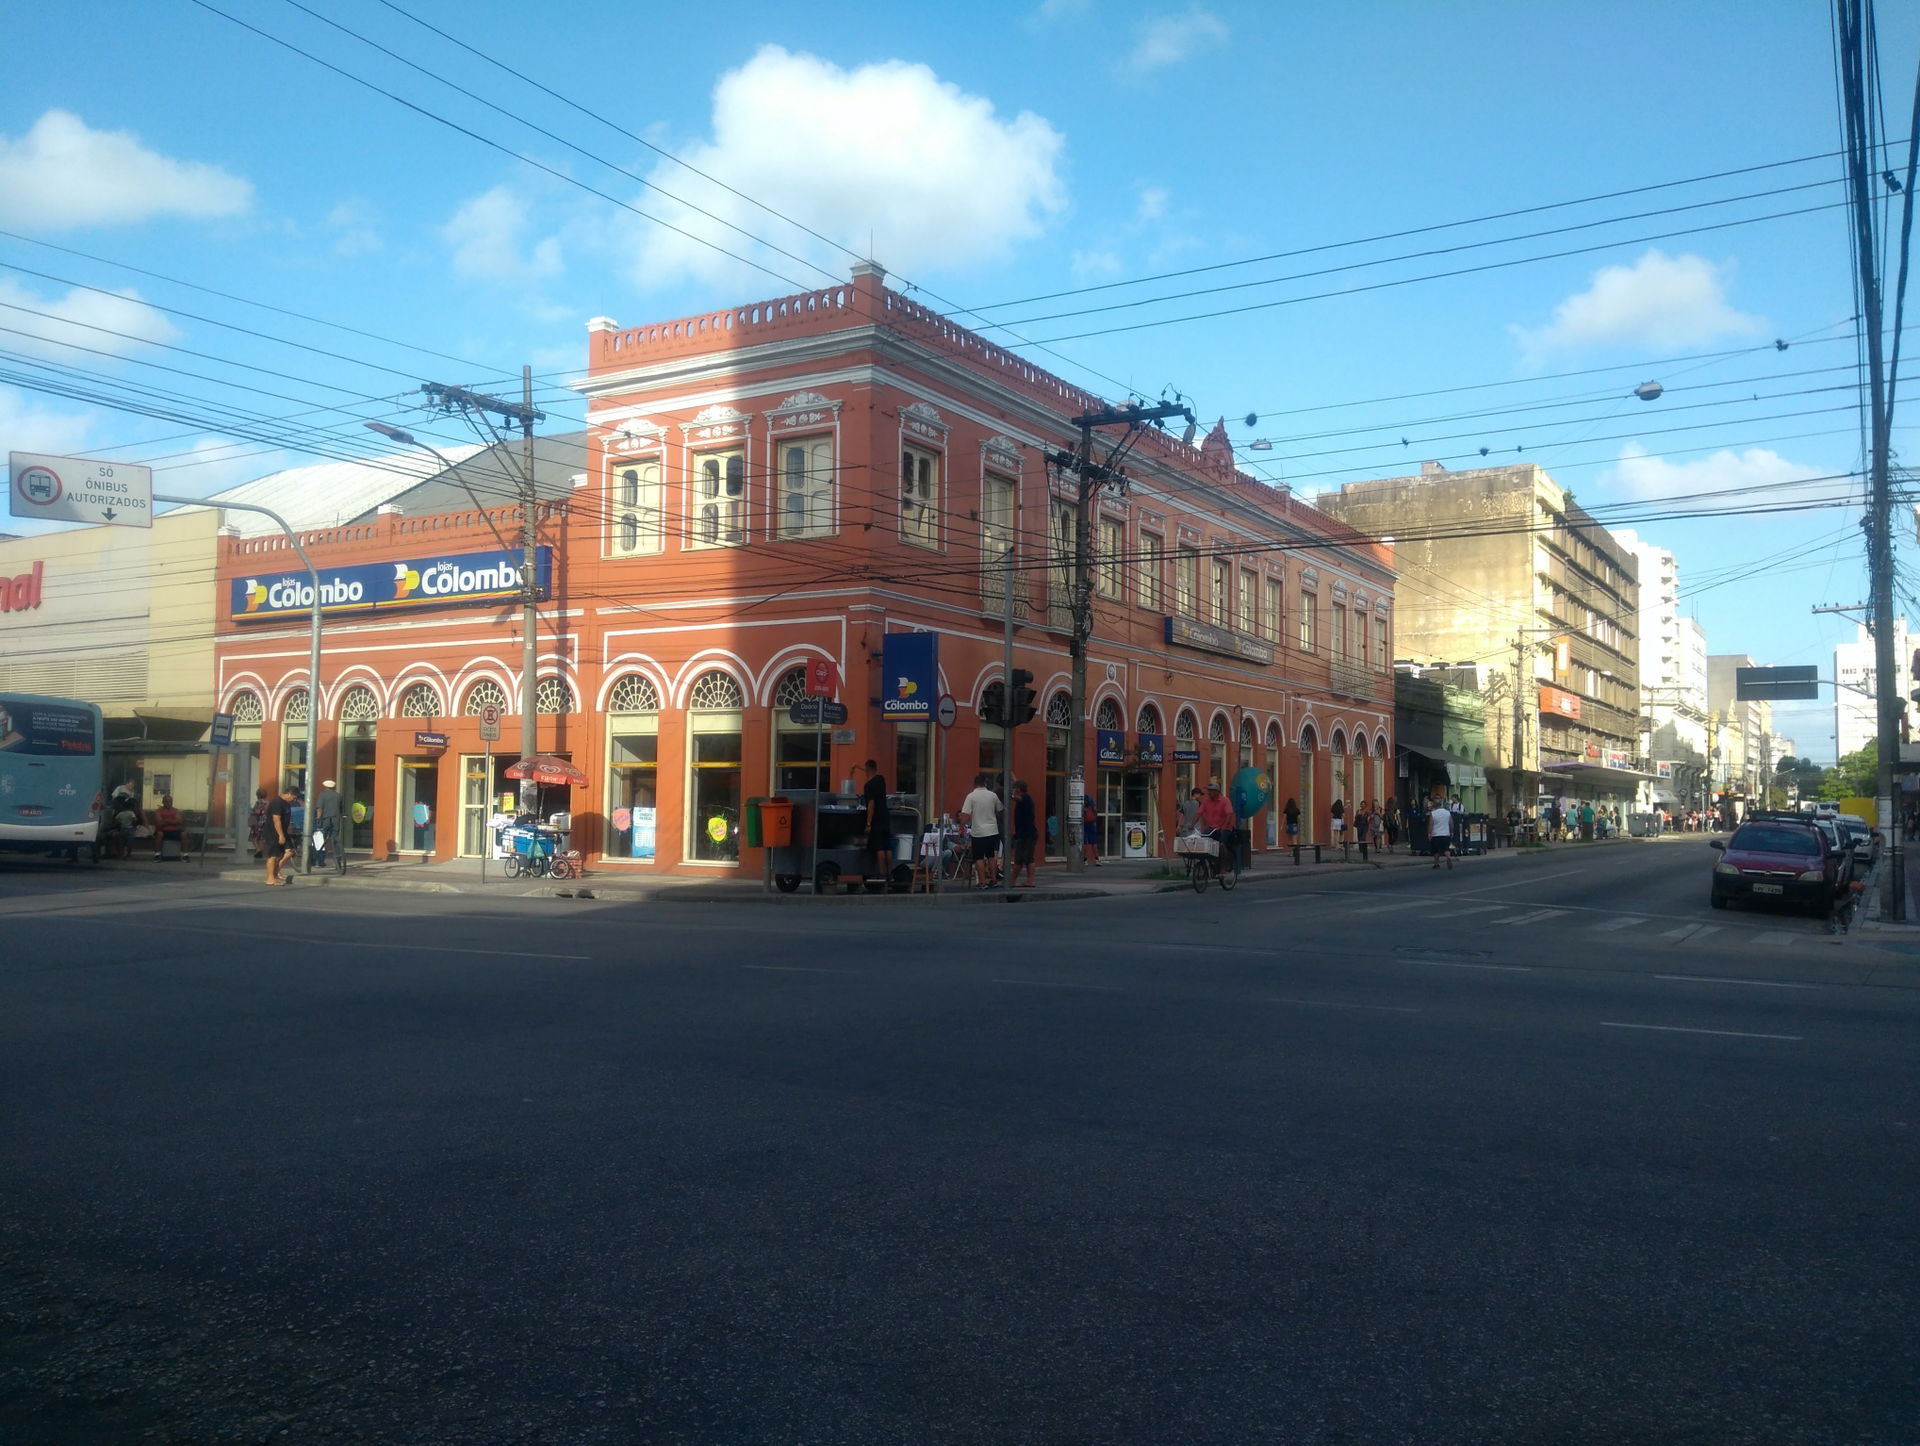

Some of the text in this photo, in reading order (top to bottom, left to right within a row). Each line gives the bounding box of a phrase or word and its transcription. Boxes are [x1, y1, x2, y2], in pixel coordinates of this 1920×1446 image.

[99, 466, 114, 477] SÓ
[85, 477, 128, 493] ÔNIBUS
[66, 492, 146, 508] AUTORIZADOS
[437, 561, 453, 574] lojas
[268, 577, 363, 608] Colombo
[884, 700, 929, 711] Colombo
